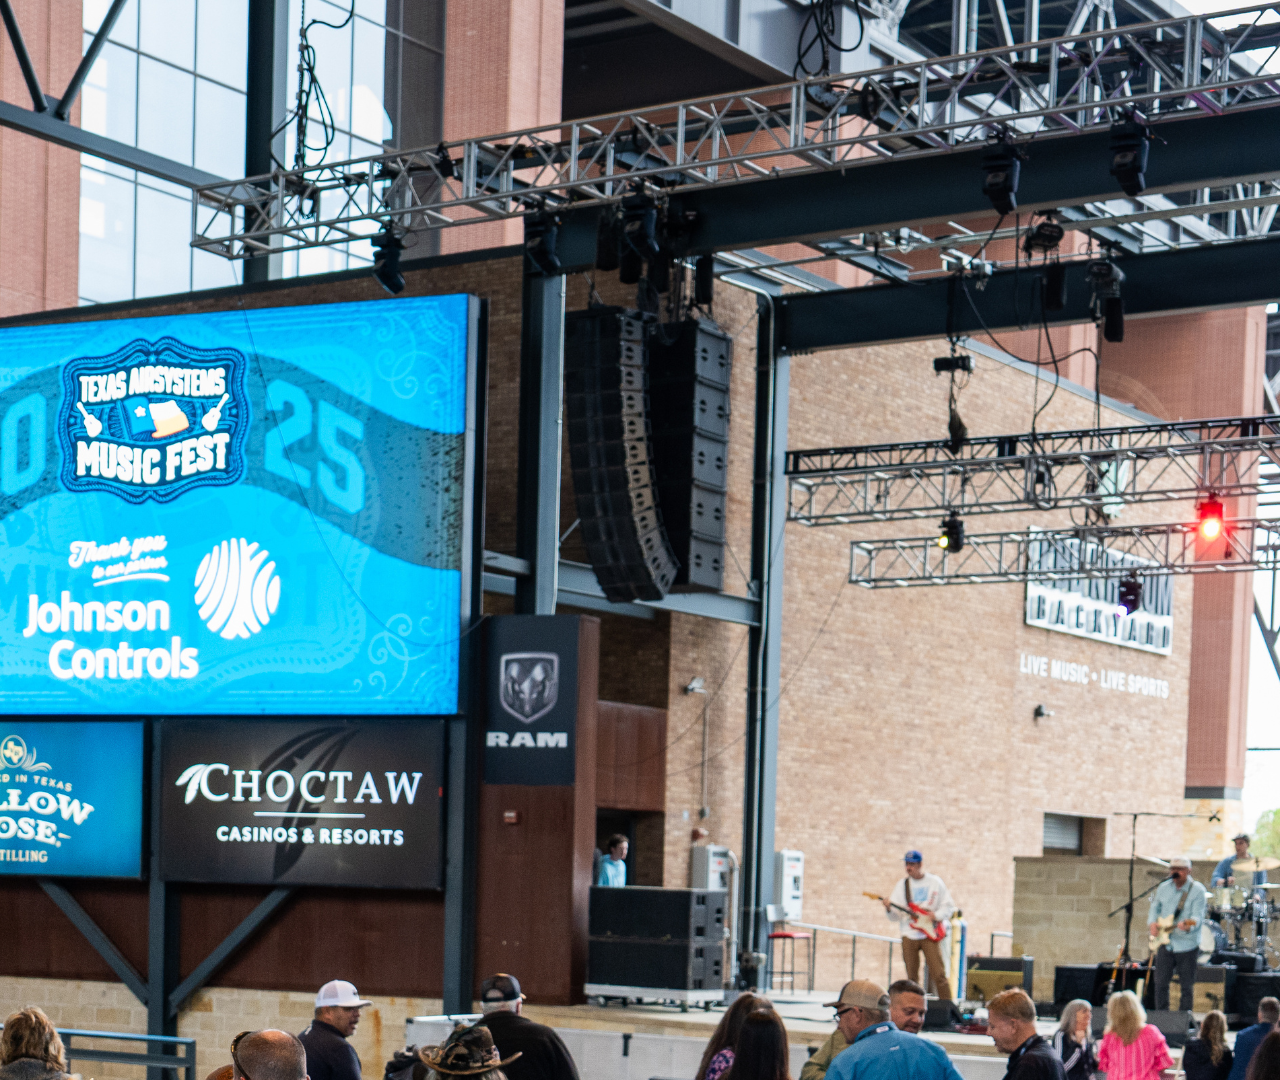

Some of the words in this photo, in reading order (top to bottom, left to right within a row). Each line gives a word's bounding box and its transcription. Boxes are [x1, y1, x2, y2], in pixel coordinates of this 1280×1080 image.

[79, 370, 126, 402] TEXAS
[128, 365, 226, 397] AIRSYSTEMS
[76, 440, 161, 484] MUSIC
[165, 433, 230, 481] FEST
[264, 381, 366, 515] 25
[68, 536, 131, 568] Thank
[130, 535, 168, 560] you
[91, 565, 105, 579] to
[105, 562, 125, 577] our
[124, 556, 168, 575] partner
[23, 590, 171, 638] Johnson
[1030, 594, 1171, 649] BACKYARD
[48, 637, 199, 680] Controls
[1020, 653, 1048, 677] LIVE
[1051, 659, 1089, 684] MUSIC
[1100, 669, 1125, 690] LIVE
[1128, 674, 1169, 699] SPORTS
[486, 731, 568, 748] RAM
[15, 774, 28, 783] IN
[33, 775, 73, 792] TEXAS
[200, 763, 423, 805] CHOCTAW
[216, 826, 298, 844] CASINOS
[301, 828, 315, 844] &
[320, 828, 404, 846] RESORTS
